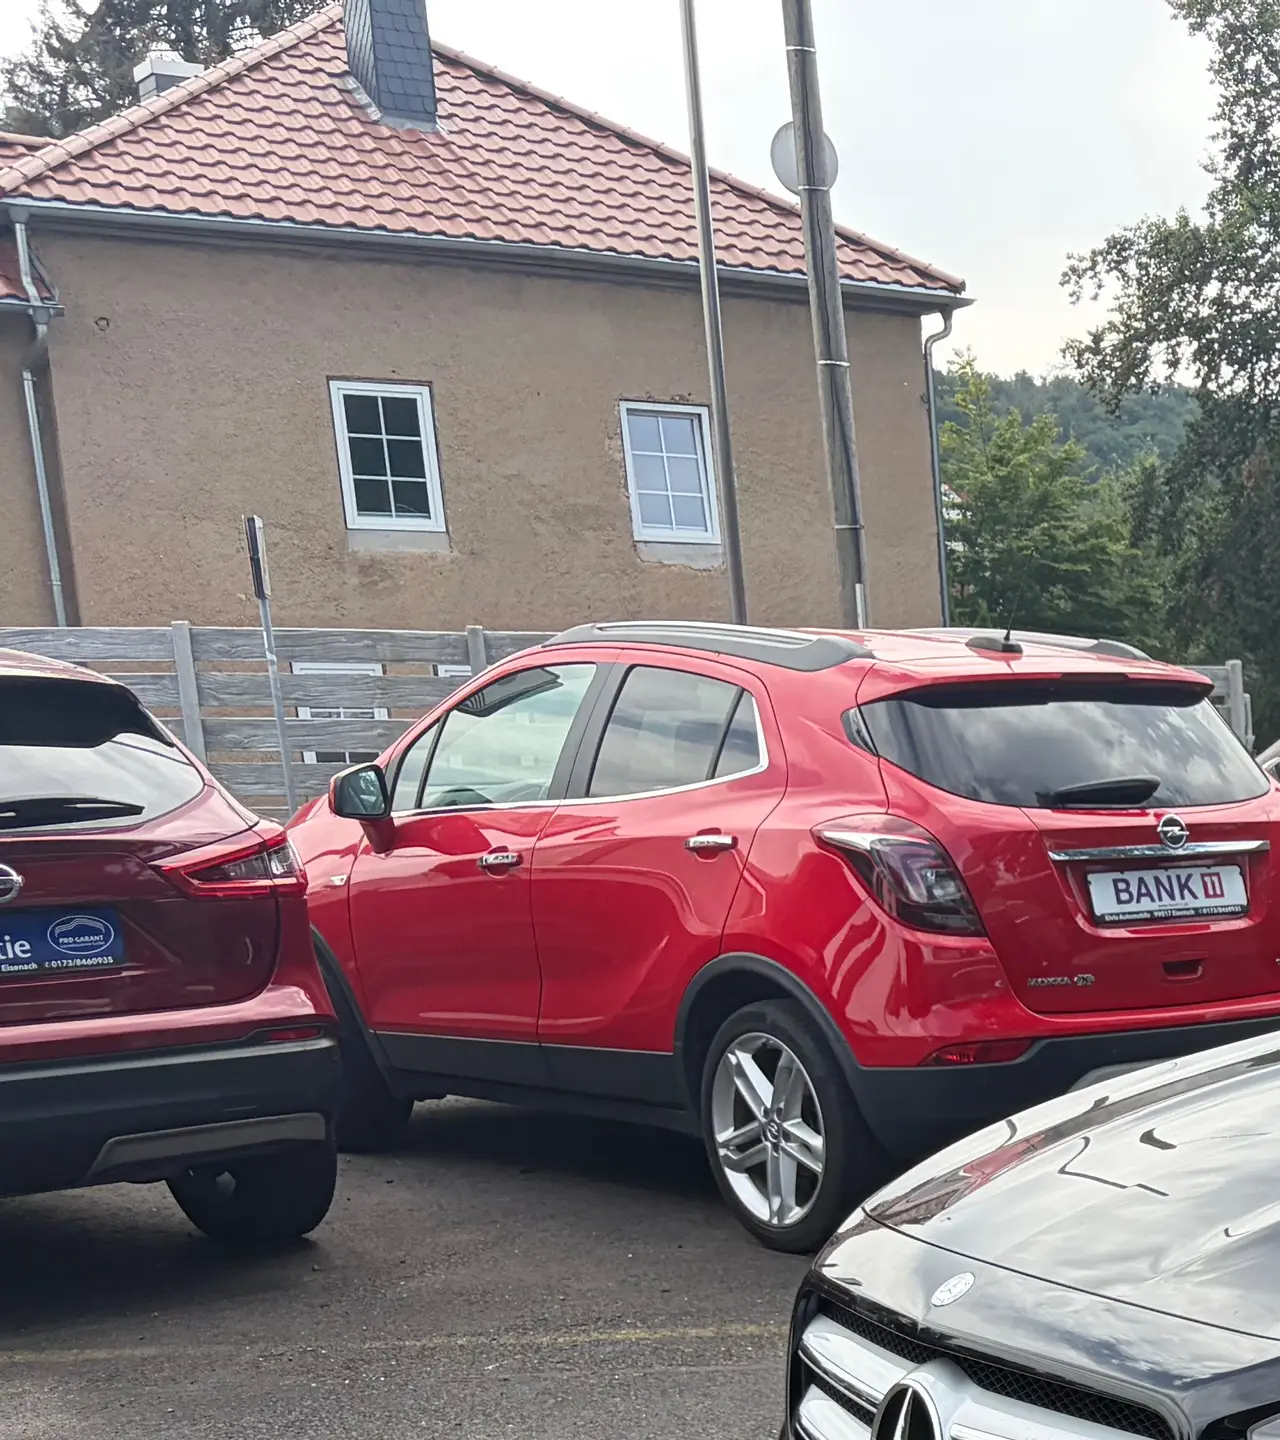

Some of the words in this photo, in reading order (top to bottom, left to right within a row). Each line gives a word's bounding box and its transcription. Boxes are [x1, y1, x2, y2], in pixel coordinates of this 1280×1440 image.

[1112, 873, 1199, 905] BANK
[75, 935, 104, 943] GARANT
[51, 956, 114, 968] 0173/8460935
